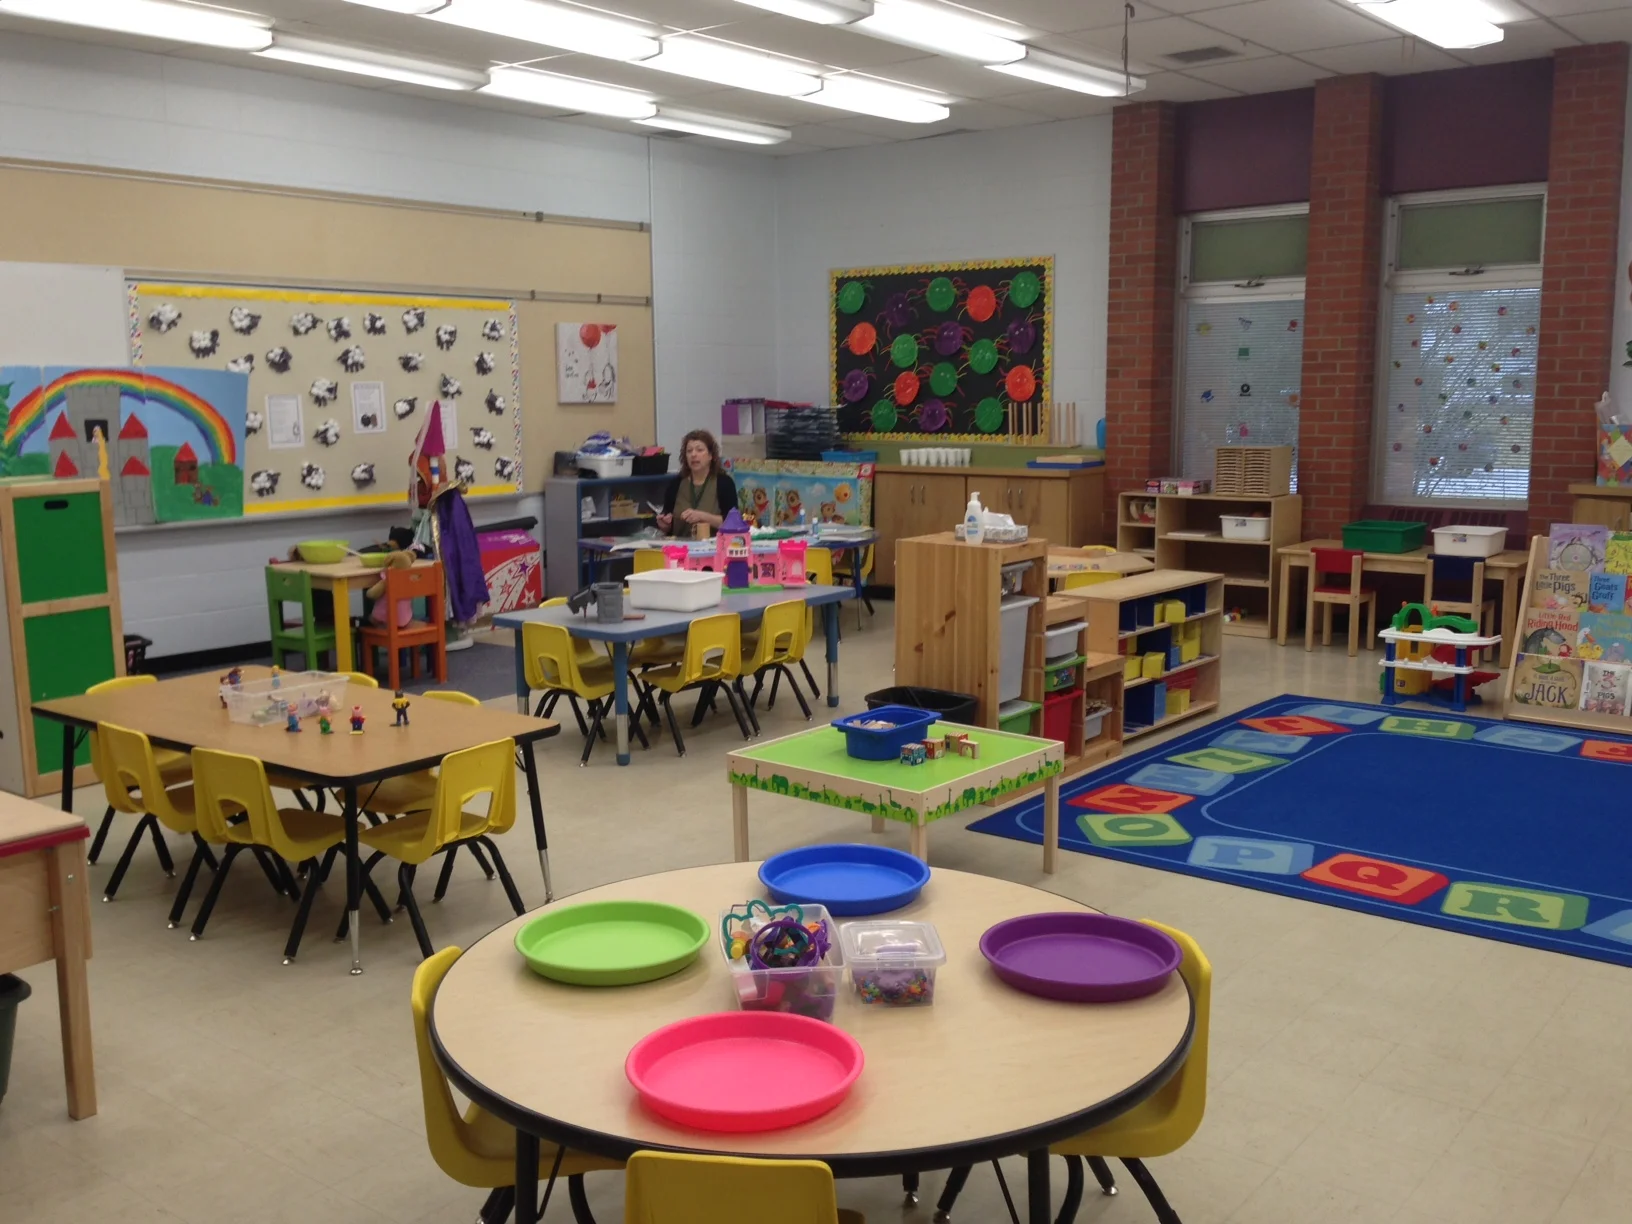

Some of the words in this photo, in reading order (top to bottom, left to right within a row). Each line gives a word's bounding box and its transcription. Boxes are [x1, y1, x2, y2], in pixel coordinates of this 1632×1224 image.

[1550, 573, 1570, 581] Three
[1594, 583, 1618, 591] Goats
[1528, 619, 1553, 628] Riding
[1556, 621, 1578, 632] Hood
[1525, 683, 1568, 704] JACK
[1101, 787, 1178, 811] N
[1104, 817, 1170, 837] O
[1207, 842, 1275, 865] P
[1329, 861, 1408, 890] Q
[1460, 890, 1549, 923] R
